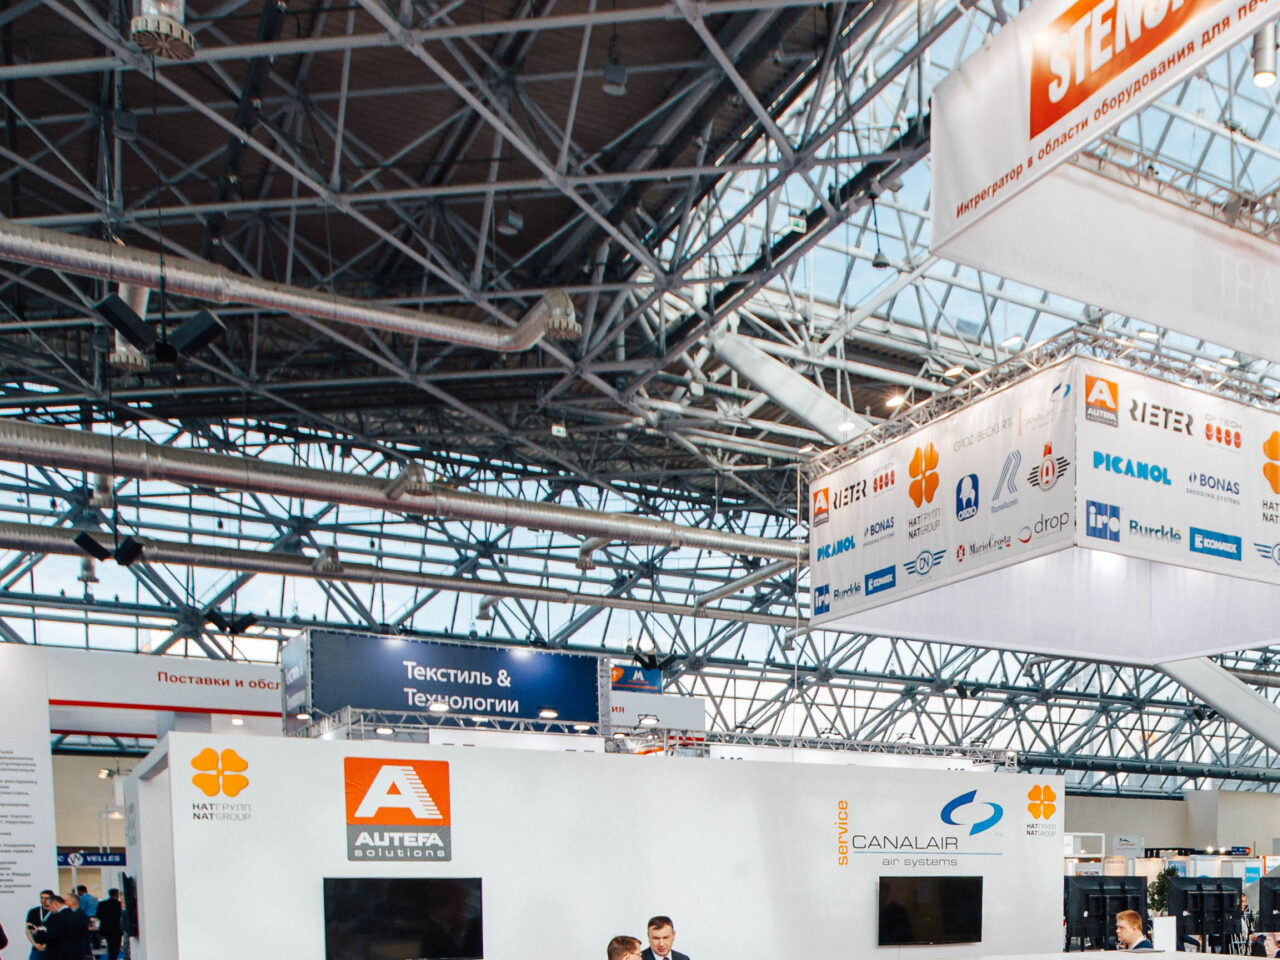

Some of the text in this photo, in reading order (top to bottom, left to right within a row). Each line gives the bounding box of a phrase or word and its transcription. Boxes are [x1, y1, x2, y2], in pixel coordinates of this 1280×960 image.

[1027, 157, 1033, 169] в
[1037, 118, 1089, 160] области
[1093, 41, 1195, 121] оборудования
[1201, 16, 1231, 47] для
[1237, 0, 1268, 22] пе
[1129, 399, 1194, 436] RIETER
[1093, 450, 1172, 485] PICANOL
[833, 479, 867, 510] RIETER
[1200, 474, 1240, 495] BONAS
[870, 516, 894, 536] BONAS
[1034, 512, 1069, 534] drop
[817, 535, 855, 562] PICANOL
[157, 671, 230, 687] Поставки
[235, 679, 244, 687] и
[402, 661, 511, 687] Текстиль &
[403, 687, 519, 713] Технологии
[192, 812, 251, 821] NATGROUP
[354, 832, 444, 846] AUTEFA
[834, 800, 848, 866] service
[852, 835, 958, 850] CANALAIR
[354, 848, 445, 857] solutions
[882, 857, 958, 868] air systems
